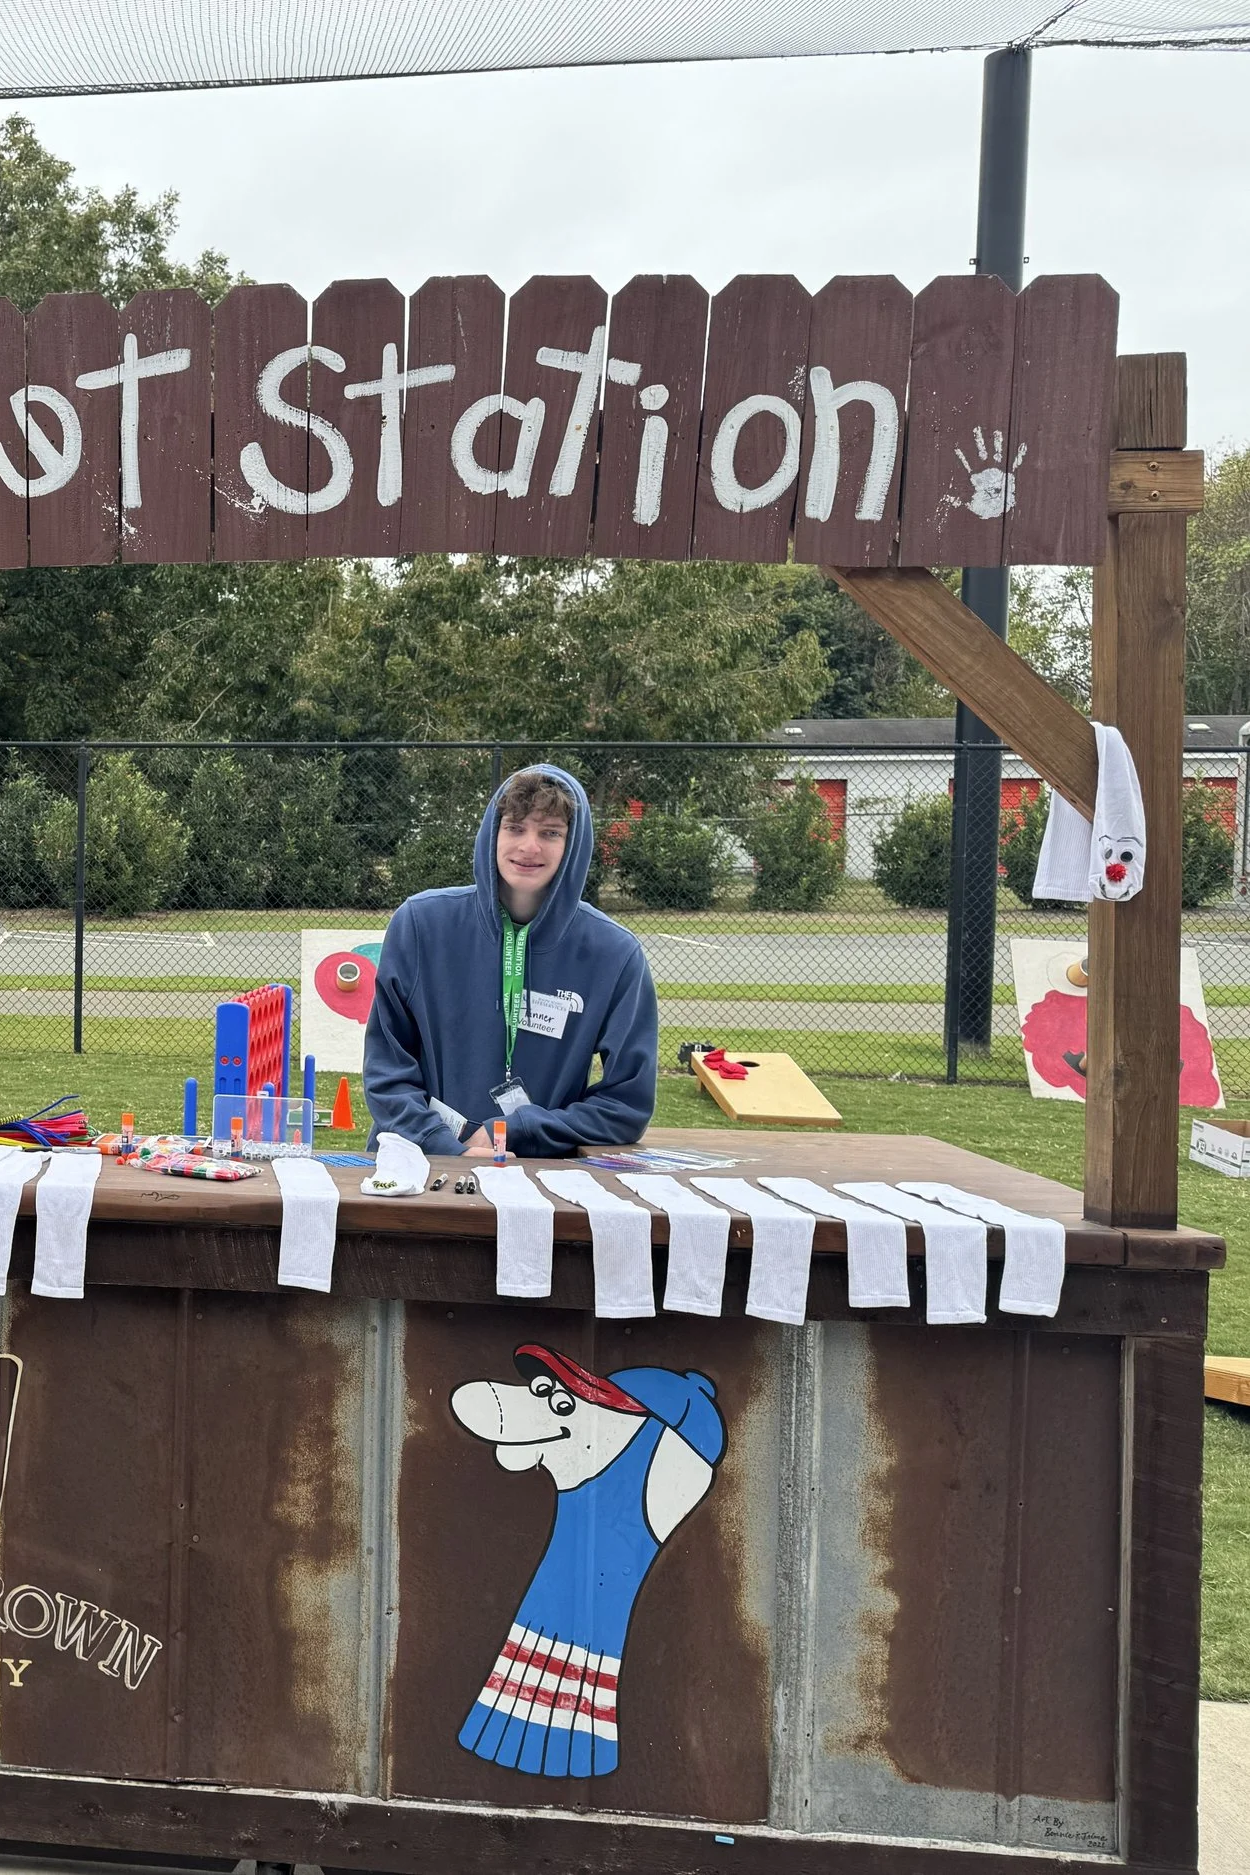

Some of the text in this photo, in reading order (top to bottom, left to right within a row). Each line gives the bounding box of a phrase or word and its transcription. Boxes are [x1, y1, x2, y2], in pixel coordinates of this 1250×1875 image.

[239, 325, 899, 527] Station
[515, 931, 525, 976] VOLUNTEER
[519, 1018, 556, 1033] Vounteer
[1033, 1815, 1050, 1825] Art
